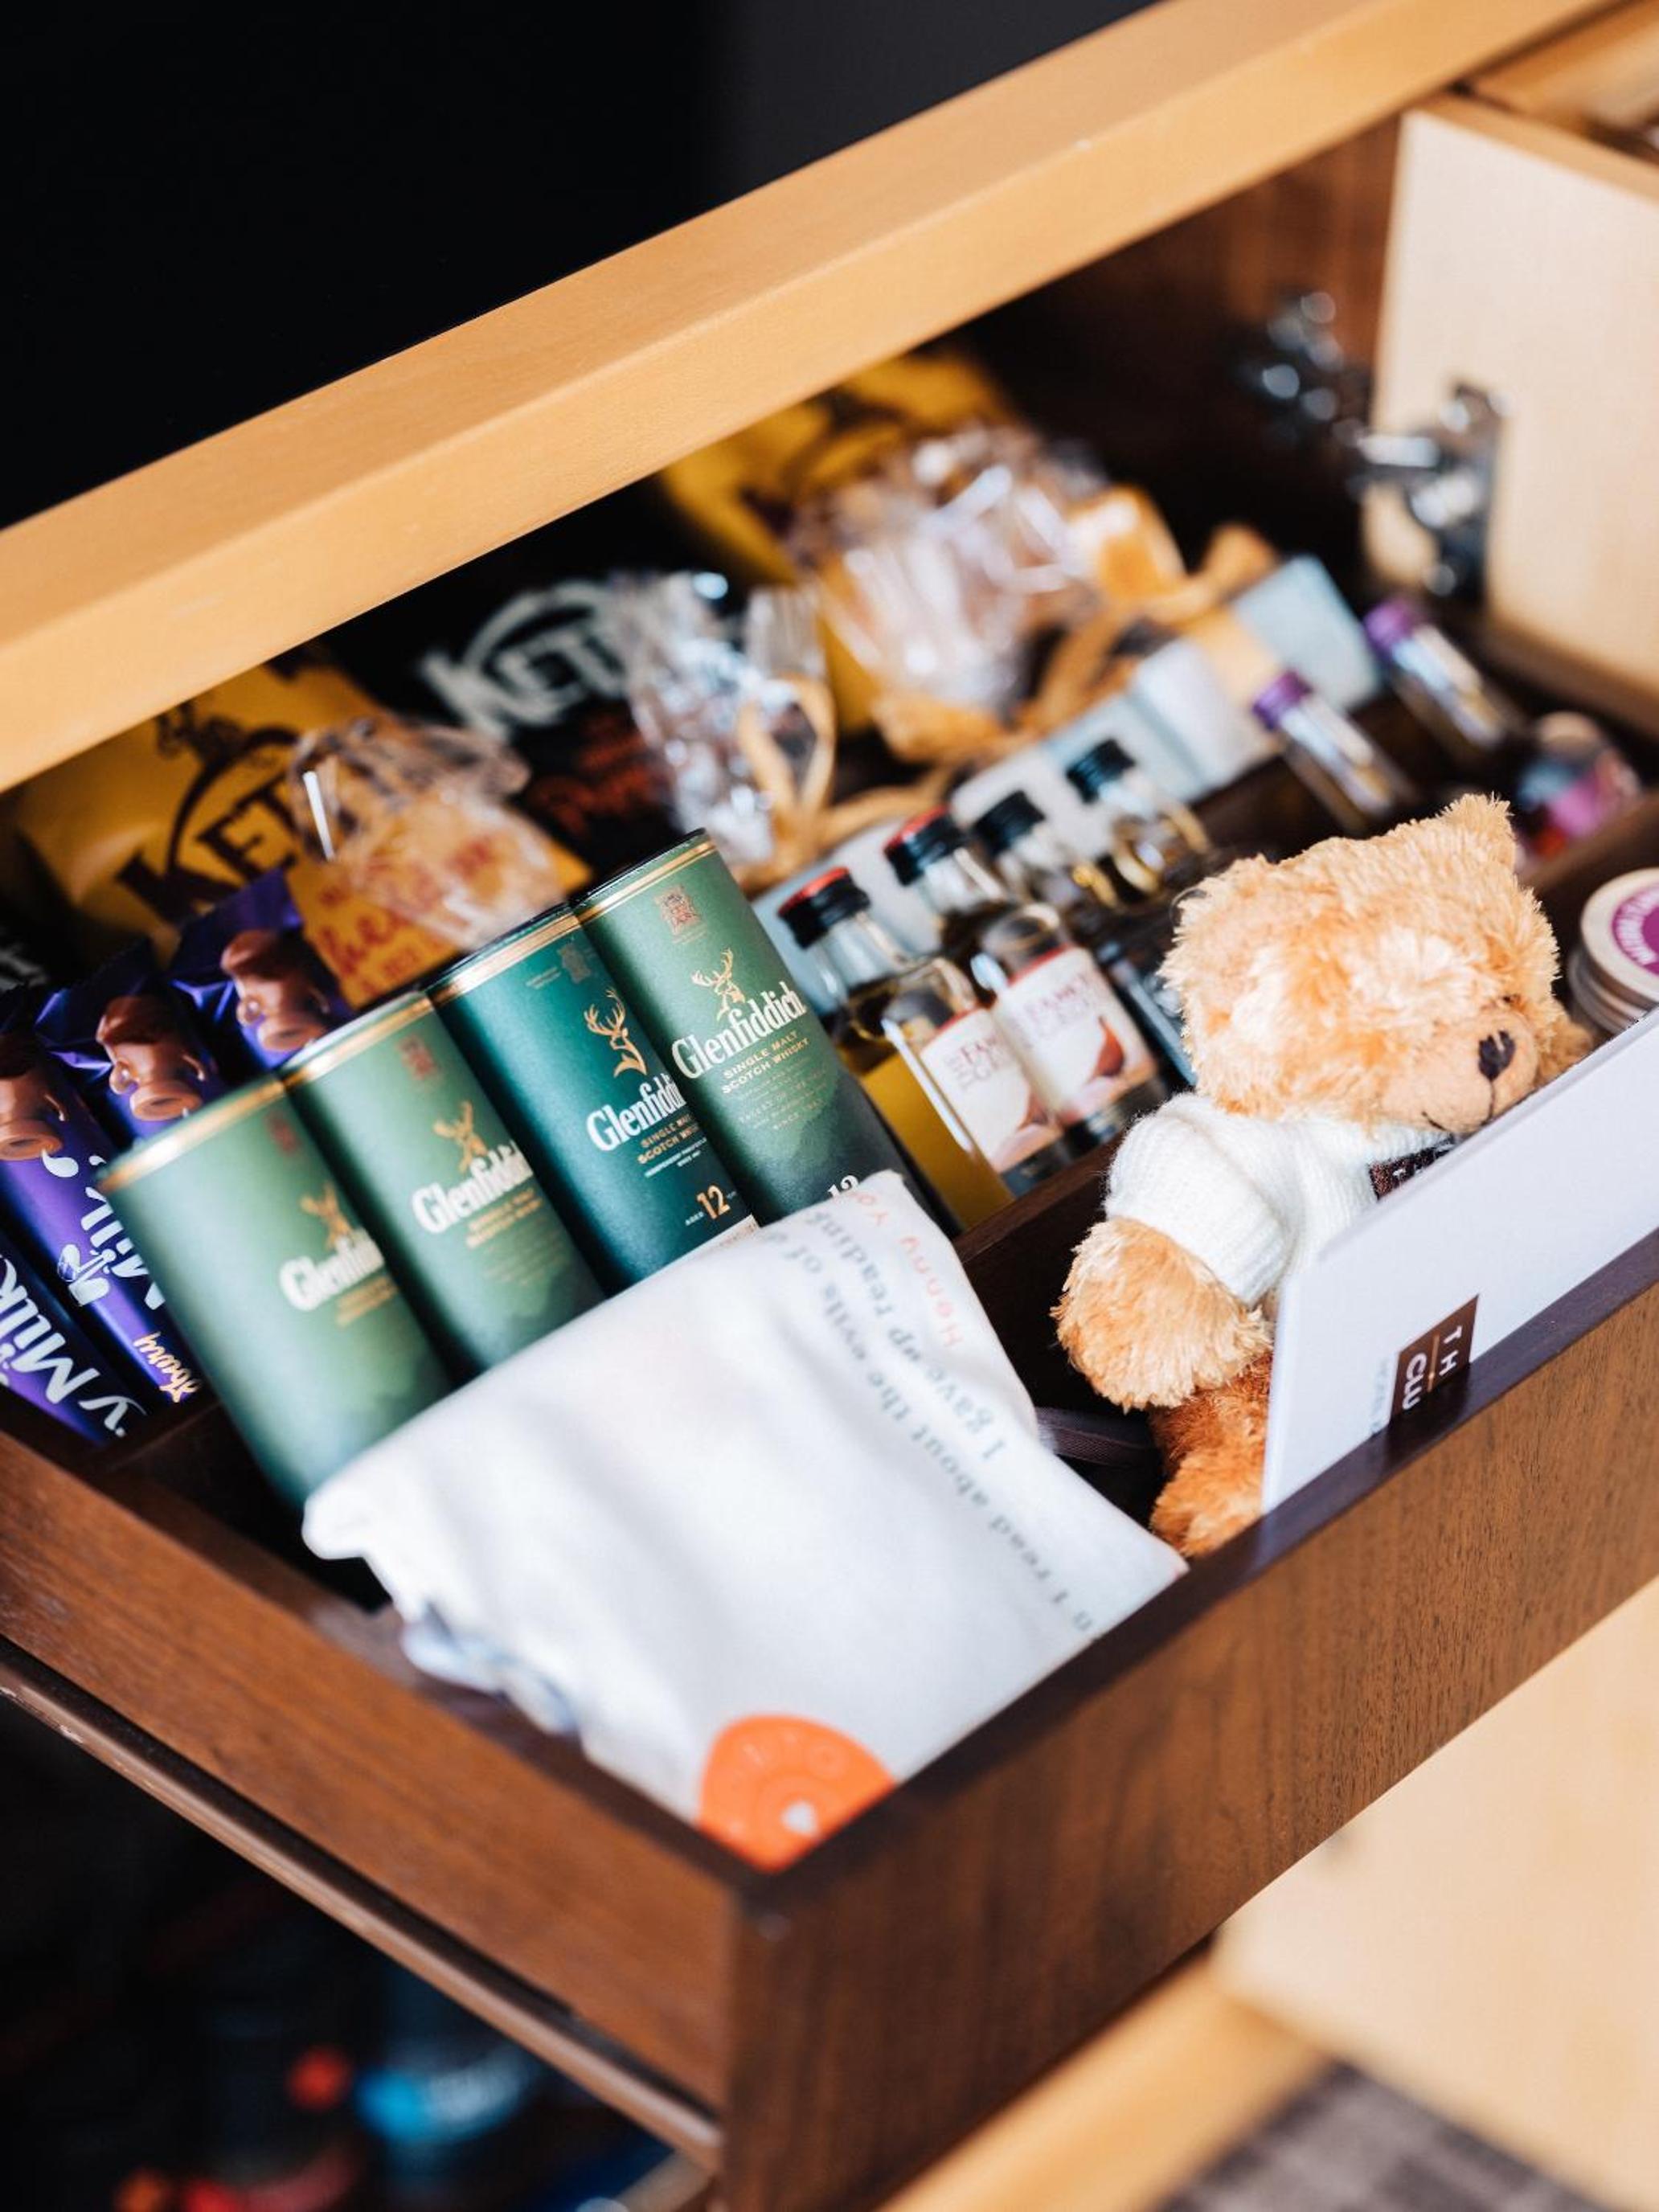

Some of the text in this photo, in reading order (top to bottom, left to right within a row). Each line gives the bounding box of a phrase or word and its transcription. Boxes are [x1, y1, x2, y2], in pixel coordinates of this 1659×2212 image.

[672, 981, 806, 1079] Glenfiddich
[725, 1030, 798, 1079] SINGLE MALT
[722, 1061, 771, 1094] SCOTCH
[637, 1136, 681, 1164] SCOTCH
[696, 1185, 731, 1219] 12
[782, 1246, 822, 1274] of
[899, 1235, 963, 1348] Henny
[822, 1284, 866, 1360] evils
[868, 1371, 911, 1421] the
[927, 1366, 993, 1434] gave
[911, 1424, 989, 1505] about
